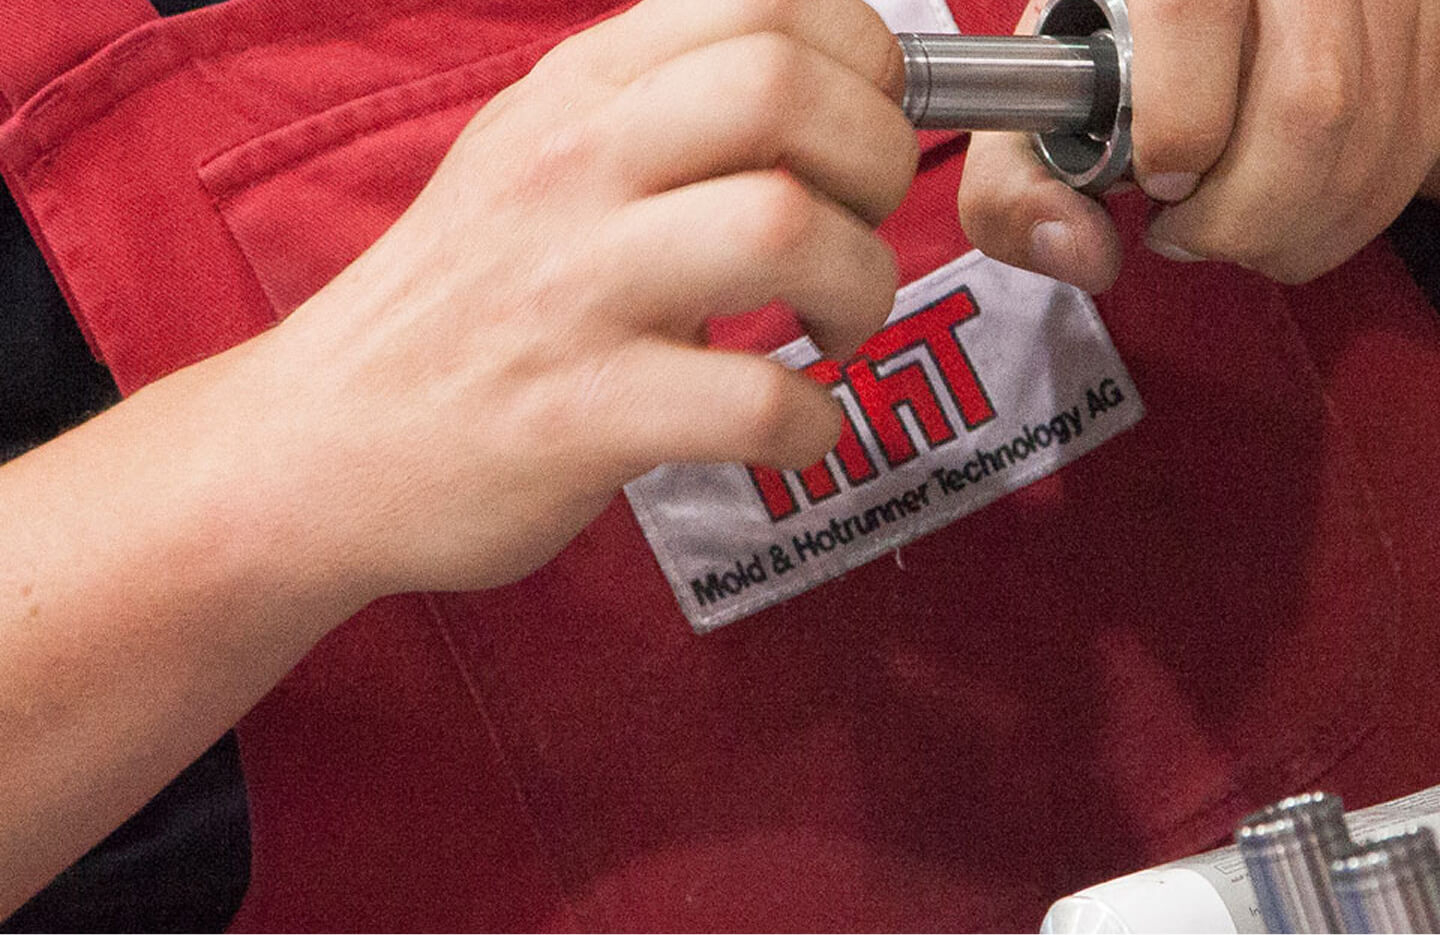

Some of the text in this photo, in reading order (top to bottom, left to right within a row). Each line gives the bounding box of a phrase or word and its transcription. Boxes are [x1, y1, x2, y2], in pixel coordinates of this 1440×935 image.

[690, 379, 1125, 606] Mold & Hotrunner Technology AG
